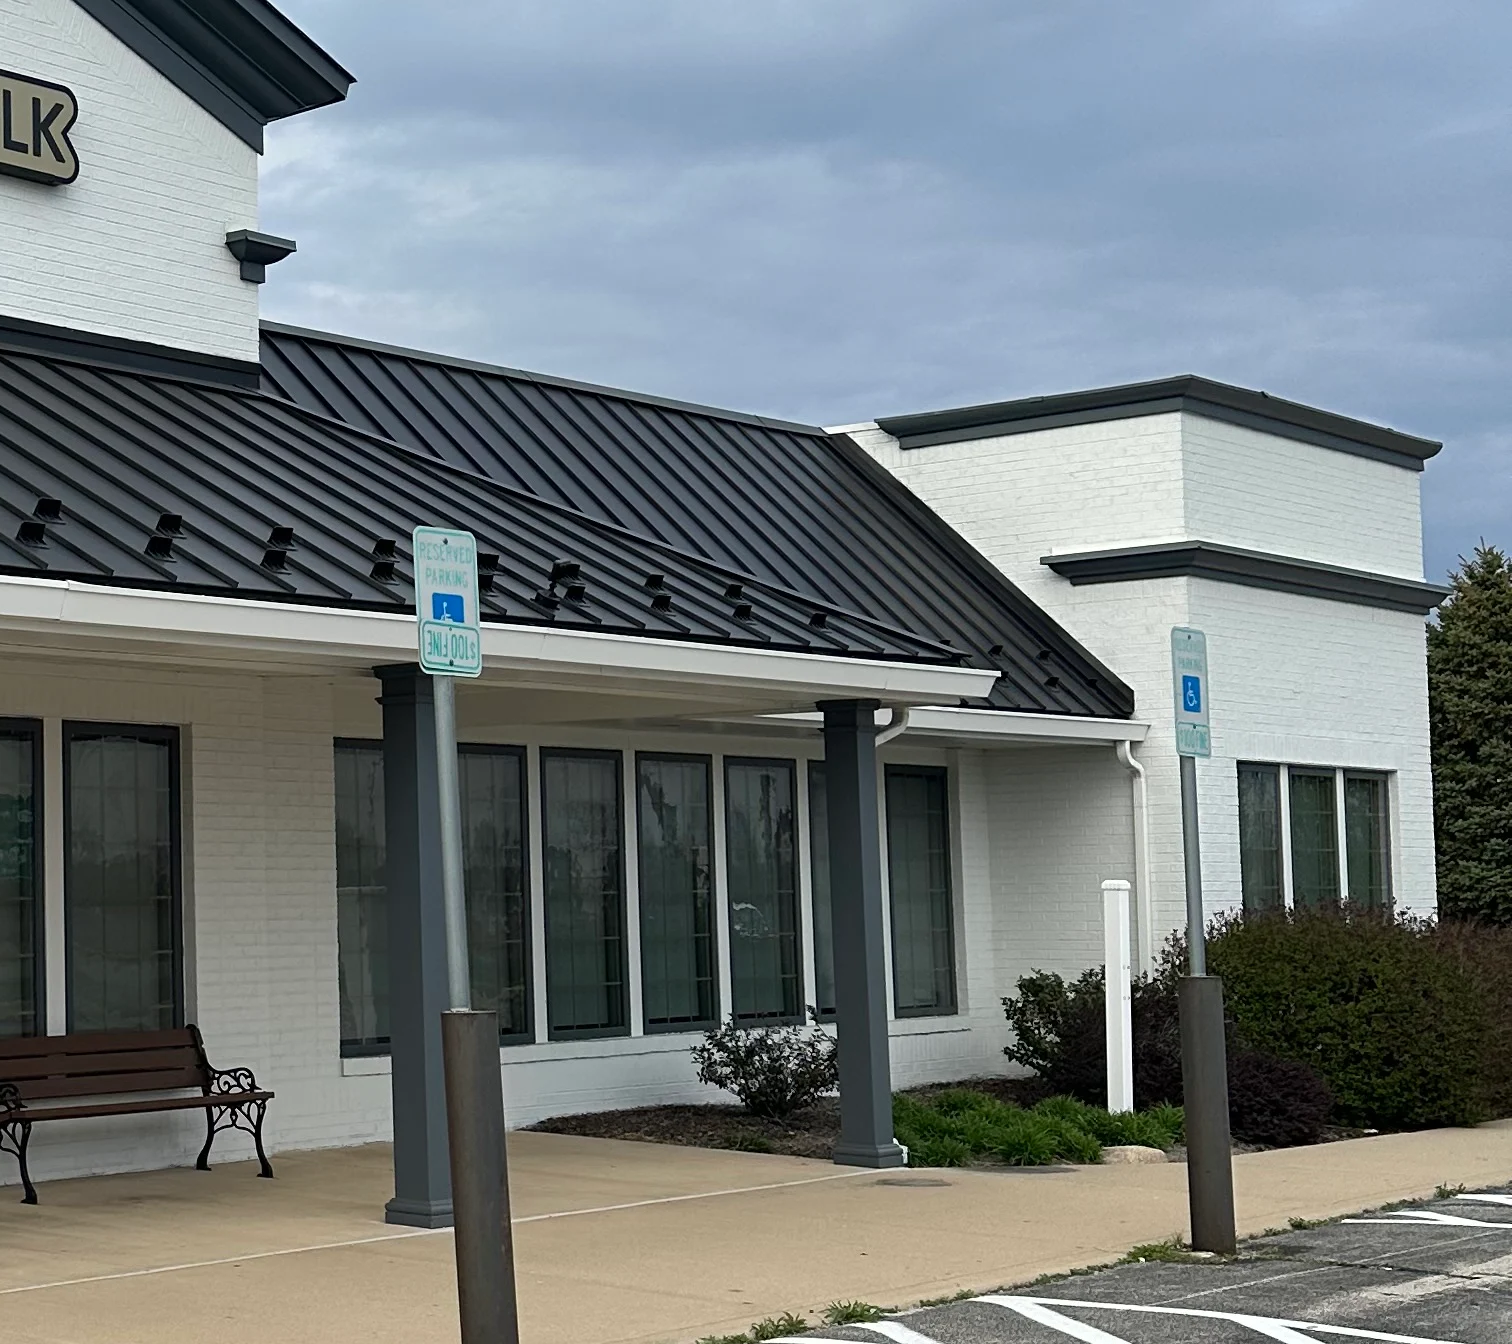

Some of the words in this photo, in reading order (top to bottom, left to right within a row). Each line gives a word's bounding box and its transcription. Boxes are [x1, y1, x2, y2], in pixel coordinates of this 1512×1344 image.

[419, 542, 473, 564] RESERVED
[425, 567, 469, 589] PARKING
[427, 630, 449, 658] FINE
[451, 633, 476, 660] $100
